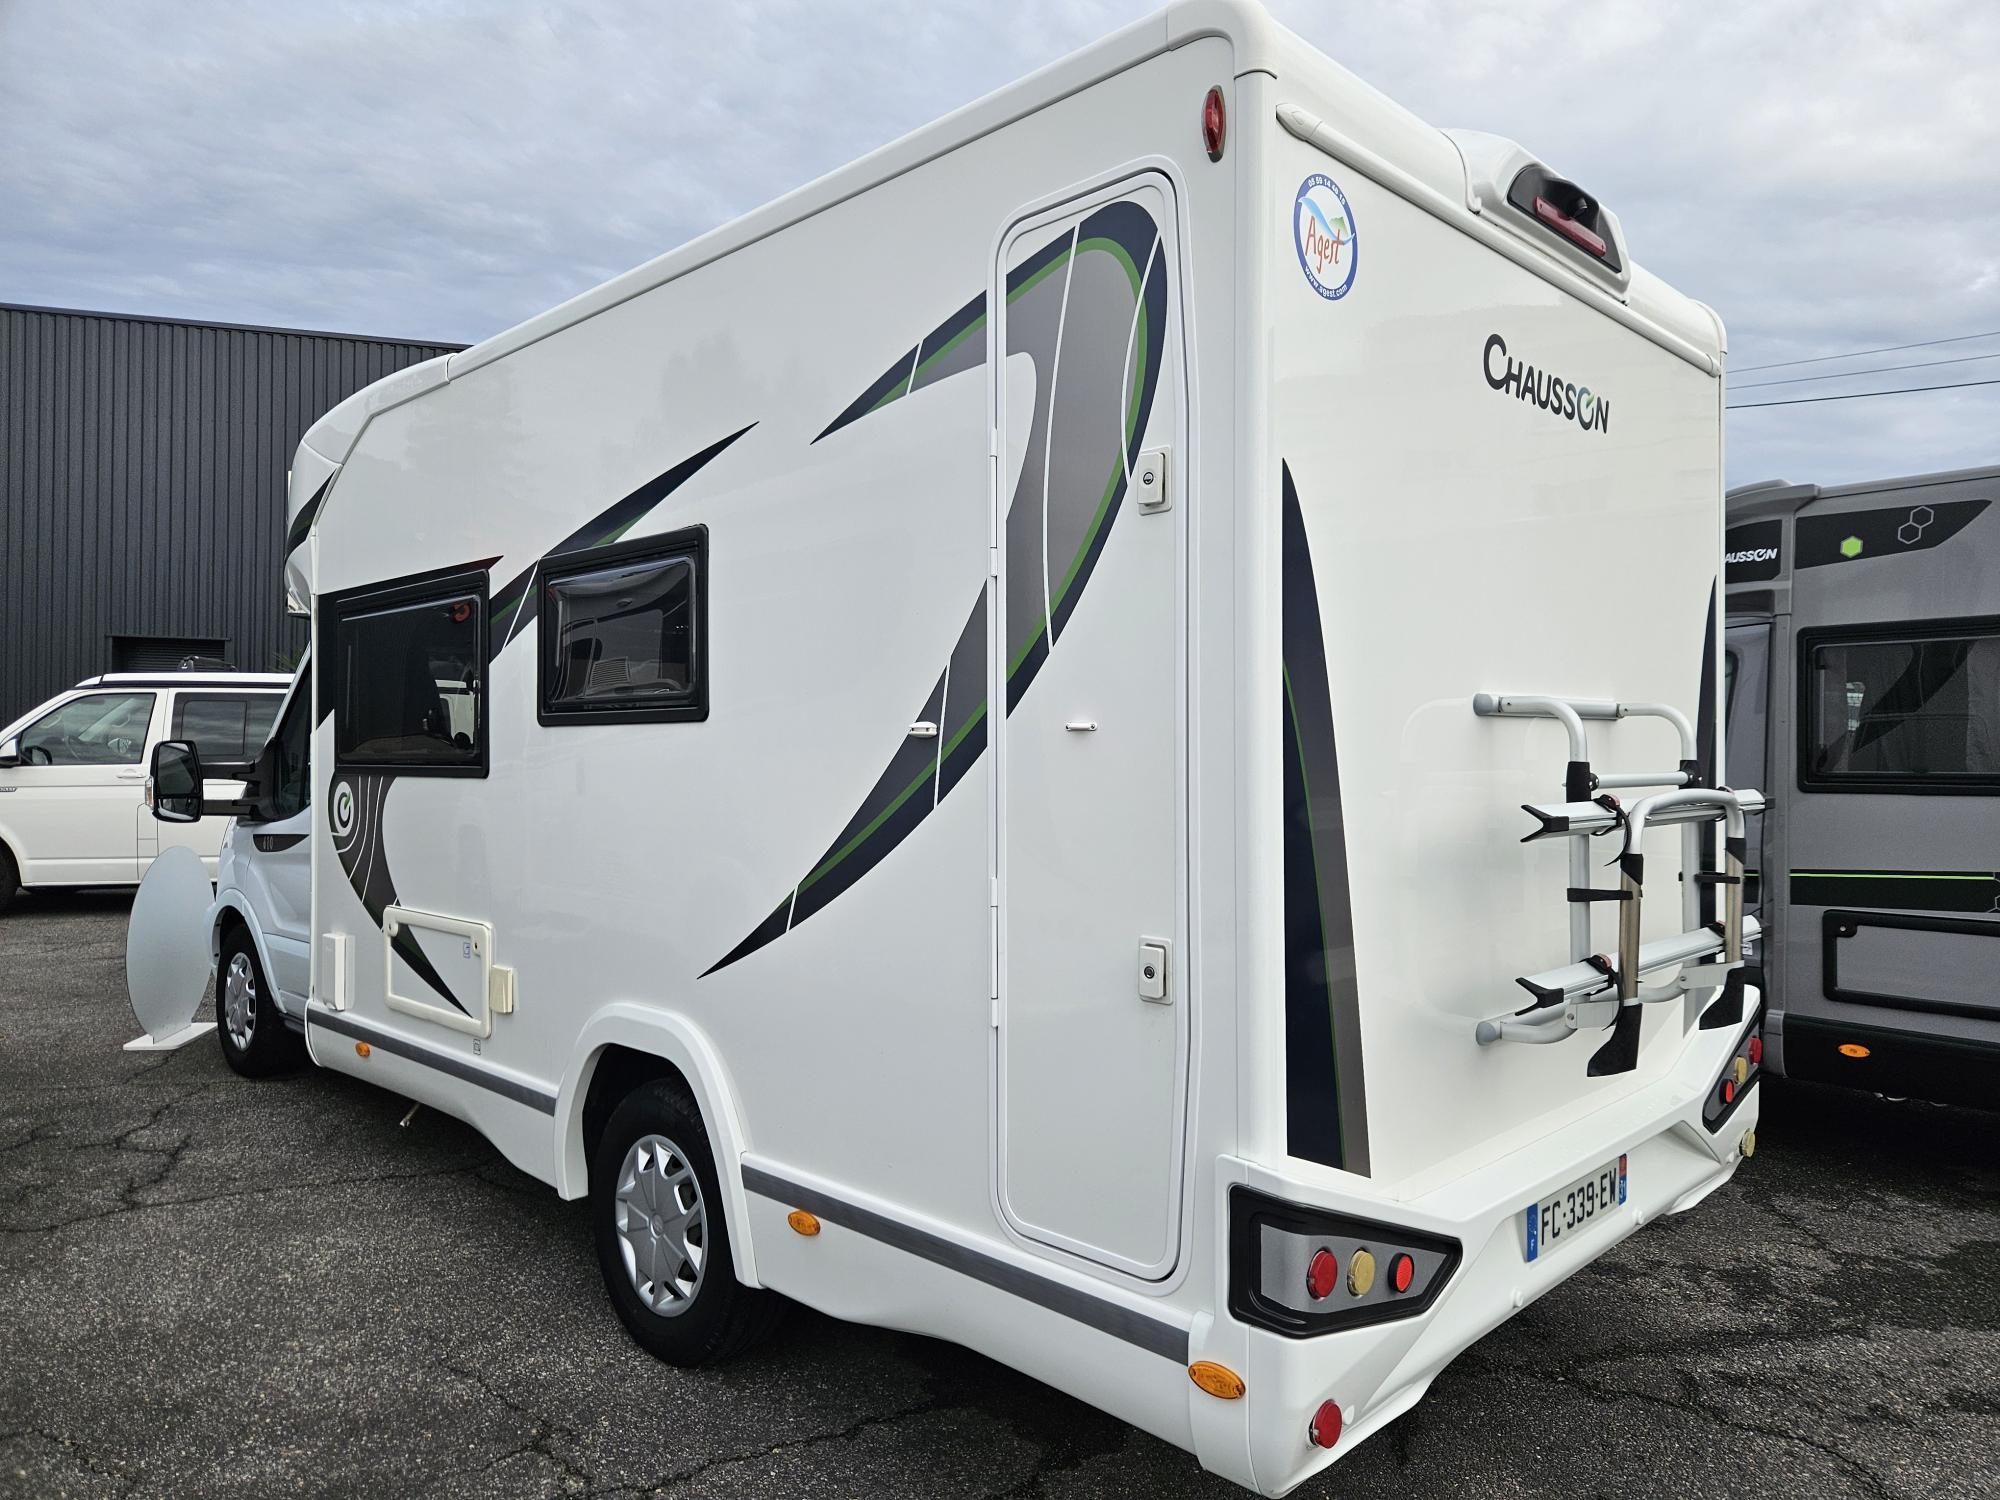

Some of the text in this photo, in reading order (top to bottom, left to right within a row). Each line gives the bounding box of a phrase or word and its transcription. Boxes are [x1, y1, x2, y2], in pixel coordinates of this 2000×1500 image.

[1305, 215, 1344, 274] Agest
[1305, 266, 1347, 297] www.agest.com
[1484, 334, 1609, 434] CHAUSSON
[1725, 548, 1777, 563] AUSSON
